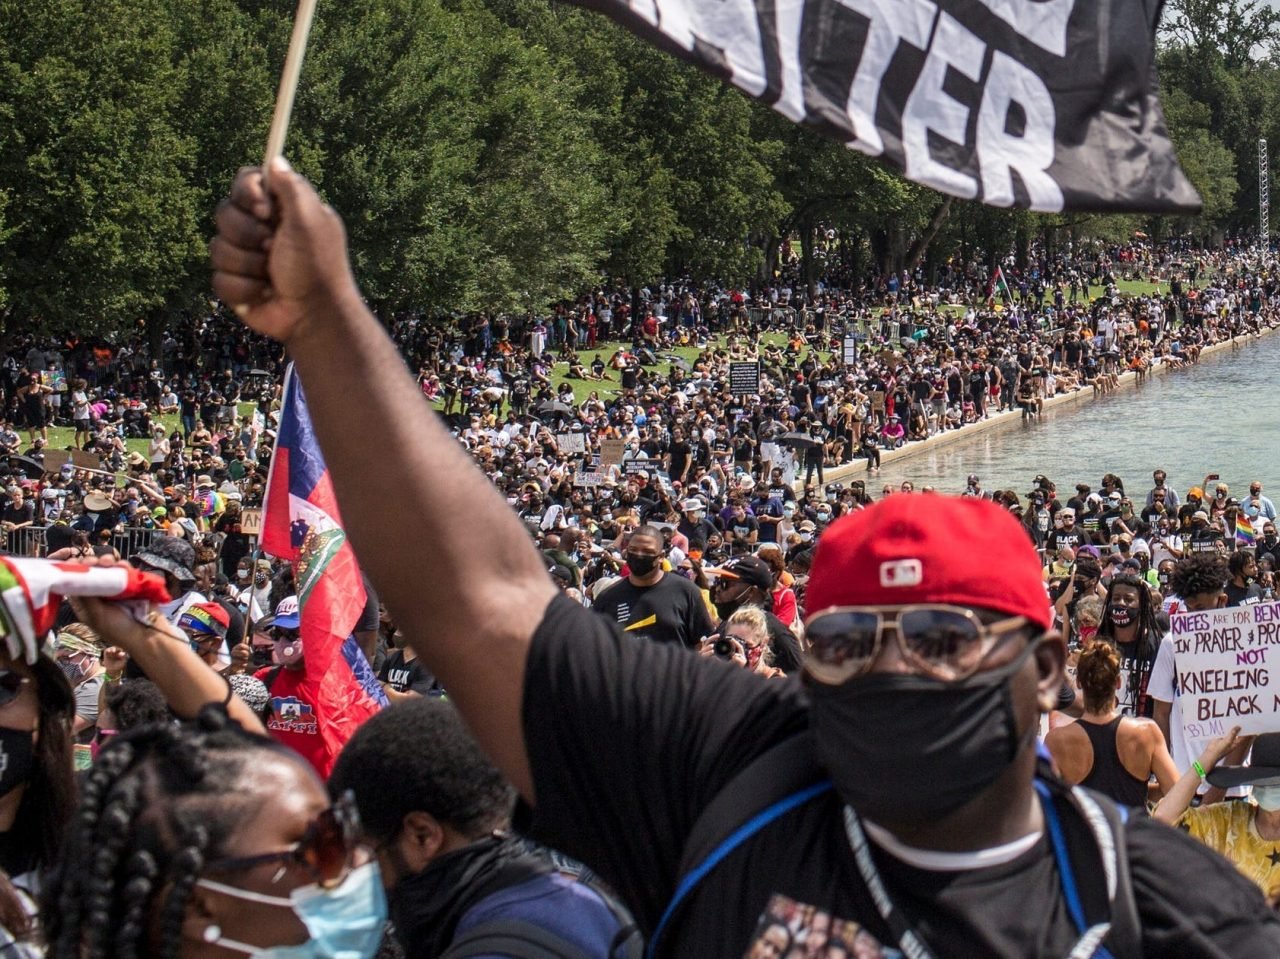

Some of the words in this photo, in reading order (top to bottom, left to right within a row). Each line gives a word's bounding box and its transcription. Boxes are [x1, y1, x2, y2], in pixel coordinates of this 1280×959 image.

[1056, 535, 1079, 543] BLACK
[1171, 613, 1210, 634] KNEES
[1213, 614, 1228, 625] ARE
[1232, 612, 1250, 624] FOR
[1174, 639, 1190, 653] IN
[1194, 627, 1244, 654] PRAYER
[1236, 647, 1268, 665] NOT
[1180, 668, 1269, 694] KNEELING
[1198, 694, 1262, 721] BLACK
[267, 719, 318, 735] AITI
